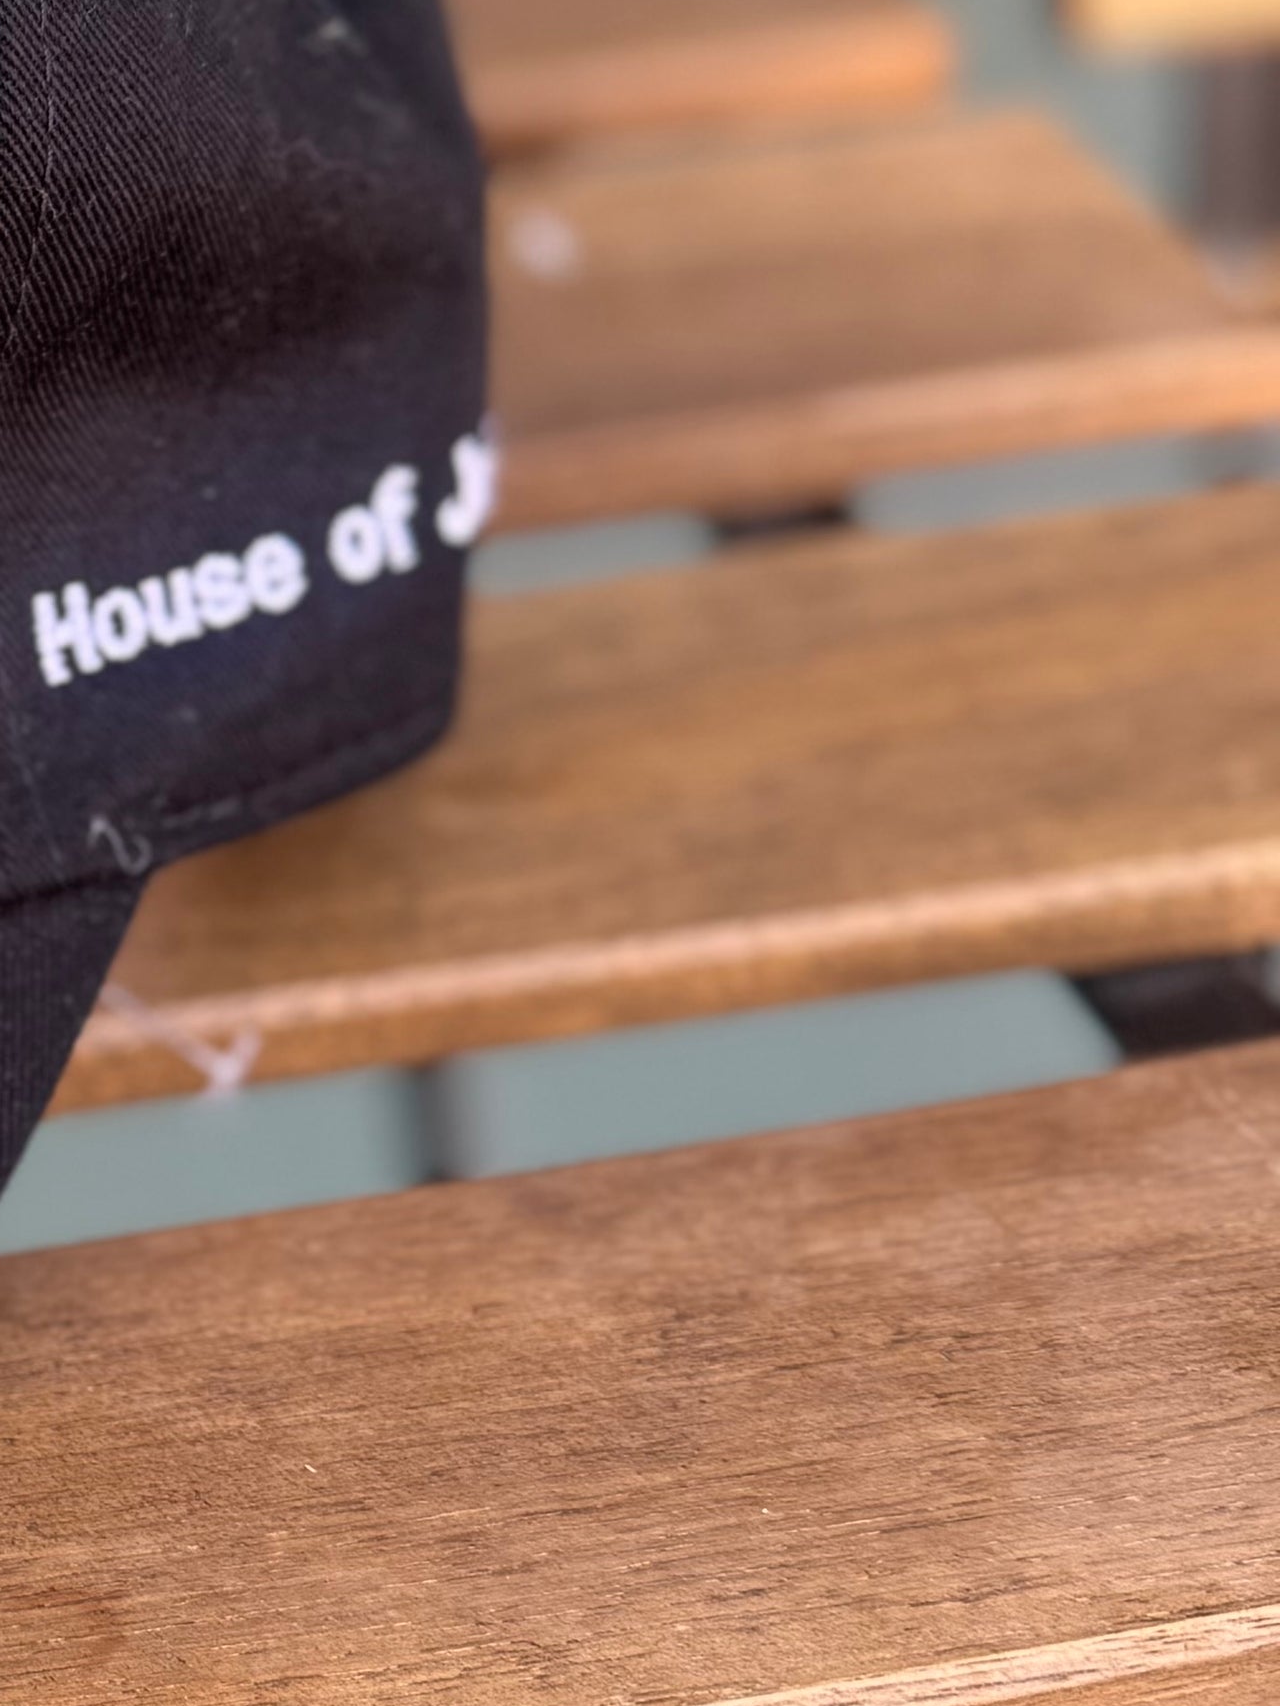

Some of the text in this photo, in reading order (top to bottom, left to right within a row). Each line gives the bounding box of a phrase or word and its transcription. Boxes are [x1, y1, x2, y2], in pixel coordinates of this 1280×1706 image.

[32, 423, 502, 687] House of J
